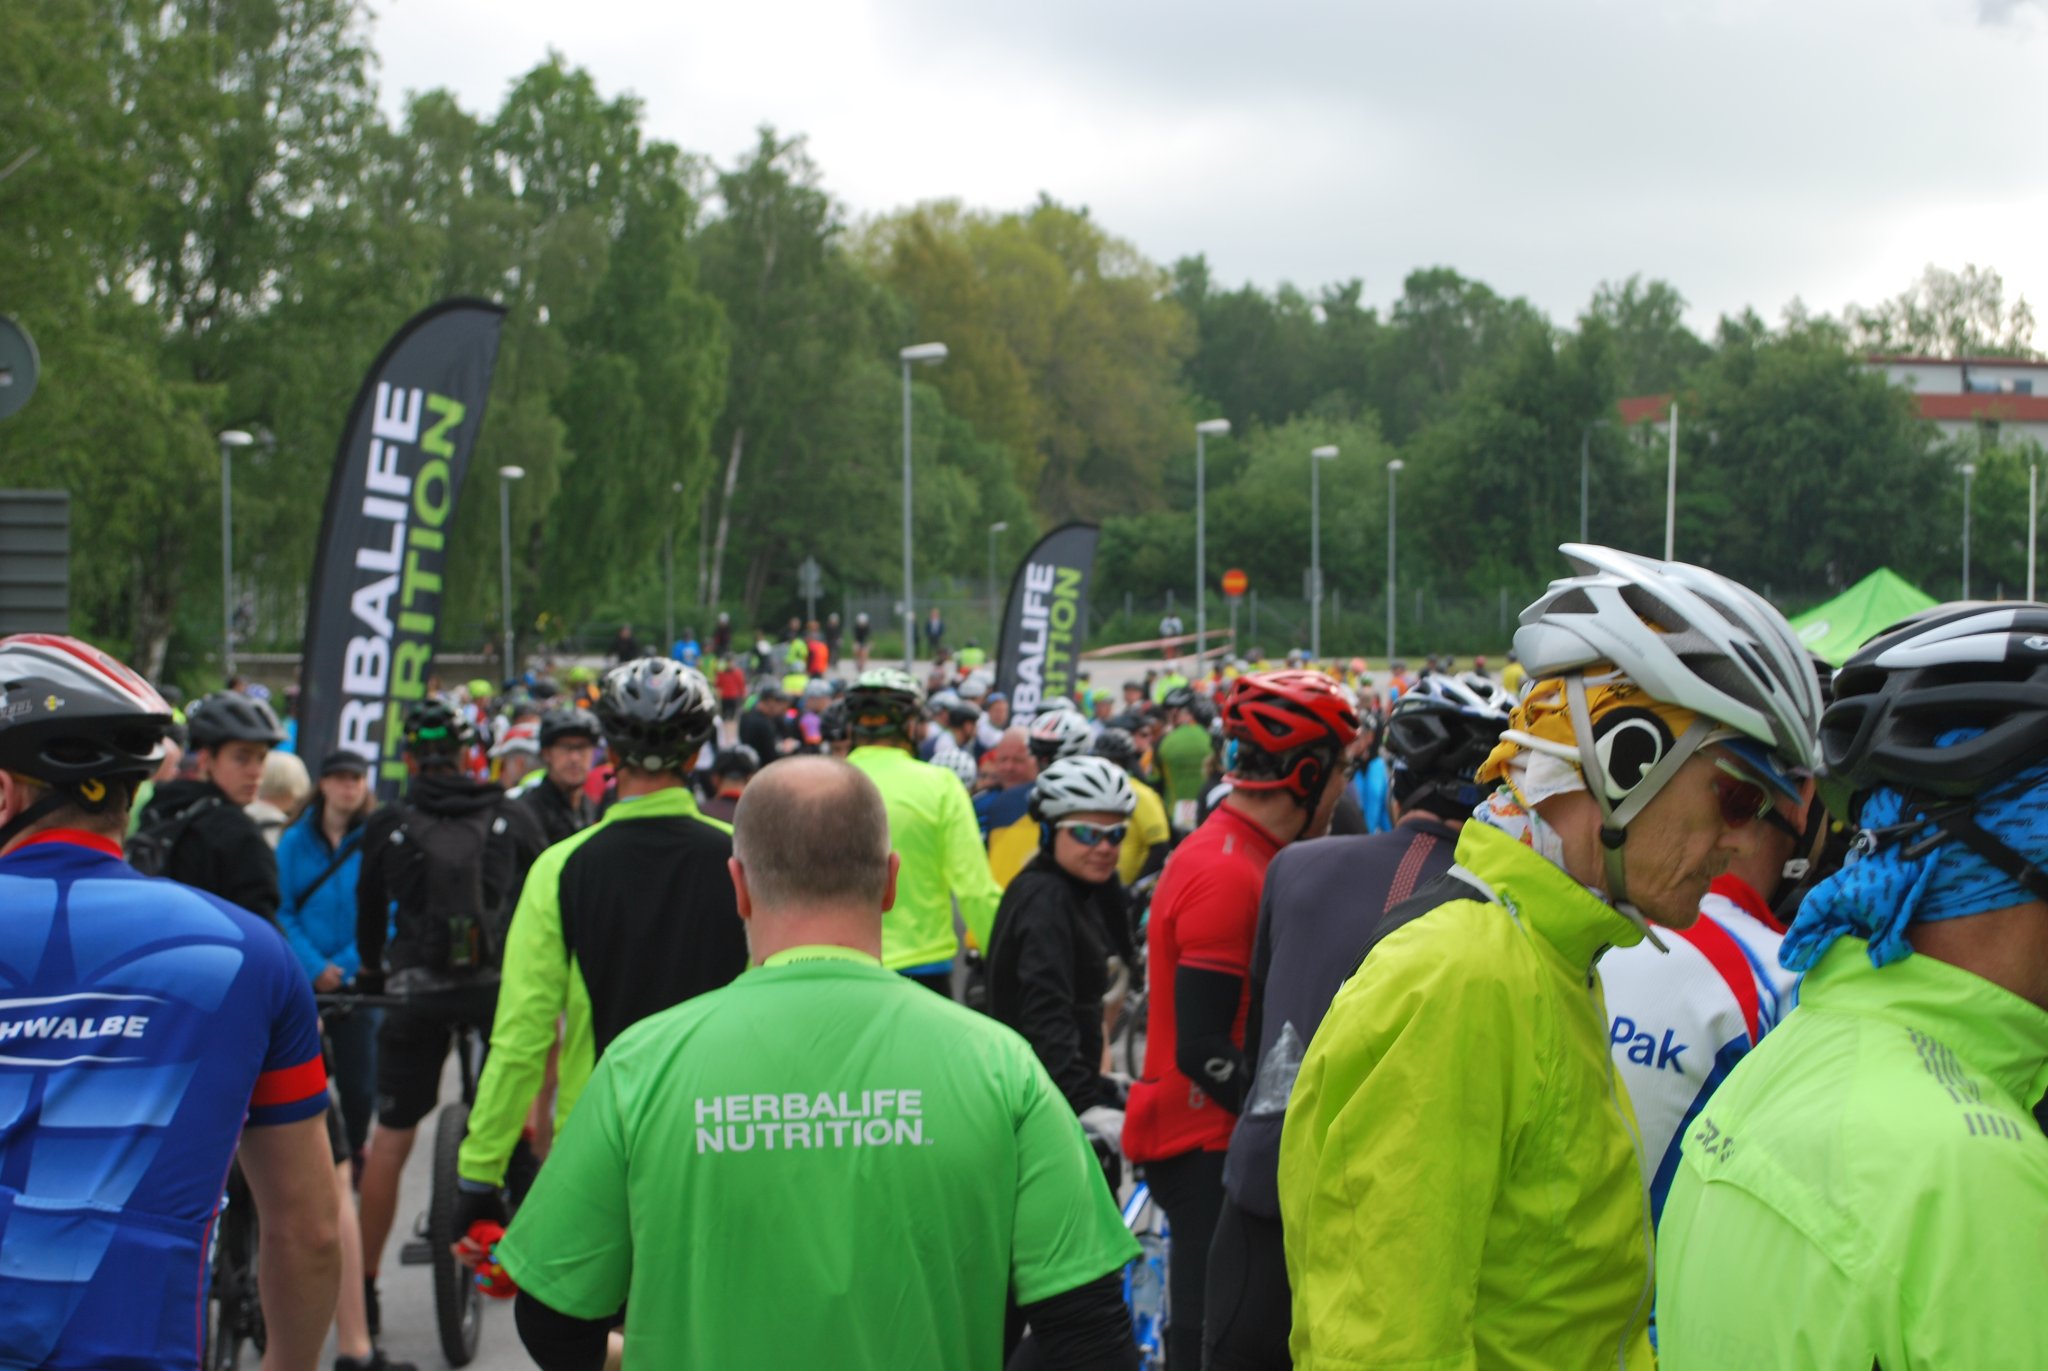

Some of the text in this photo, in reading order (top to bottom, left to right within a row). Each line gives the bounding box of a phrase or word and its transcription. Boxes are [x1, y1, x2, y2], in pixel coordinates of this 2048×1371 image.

[337, 382, 423, 791] RBALIFE
[0, 1015, 149, 1041] HWALBE
[1610, 1016, 1689, 1075] Pak
[694, 1089, 923, 1124] HERBALIFE
[696, 1118, 923, 1154] NUTRITION
